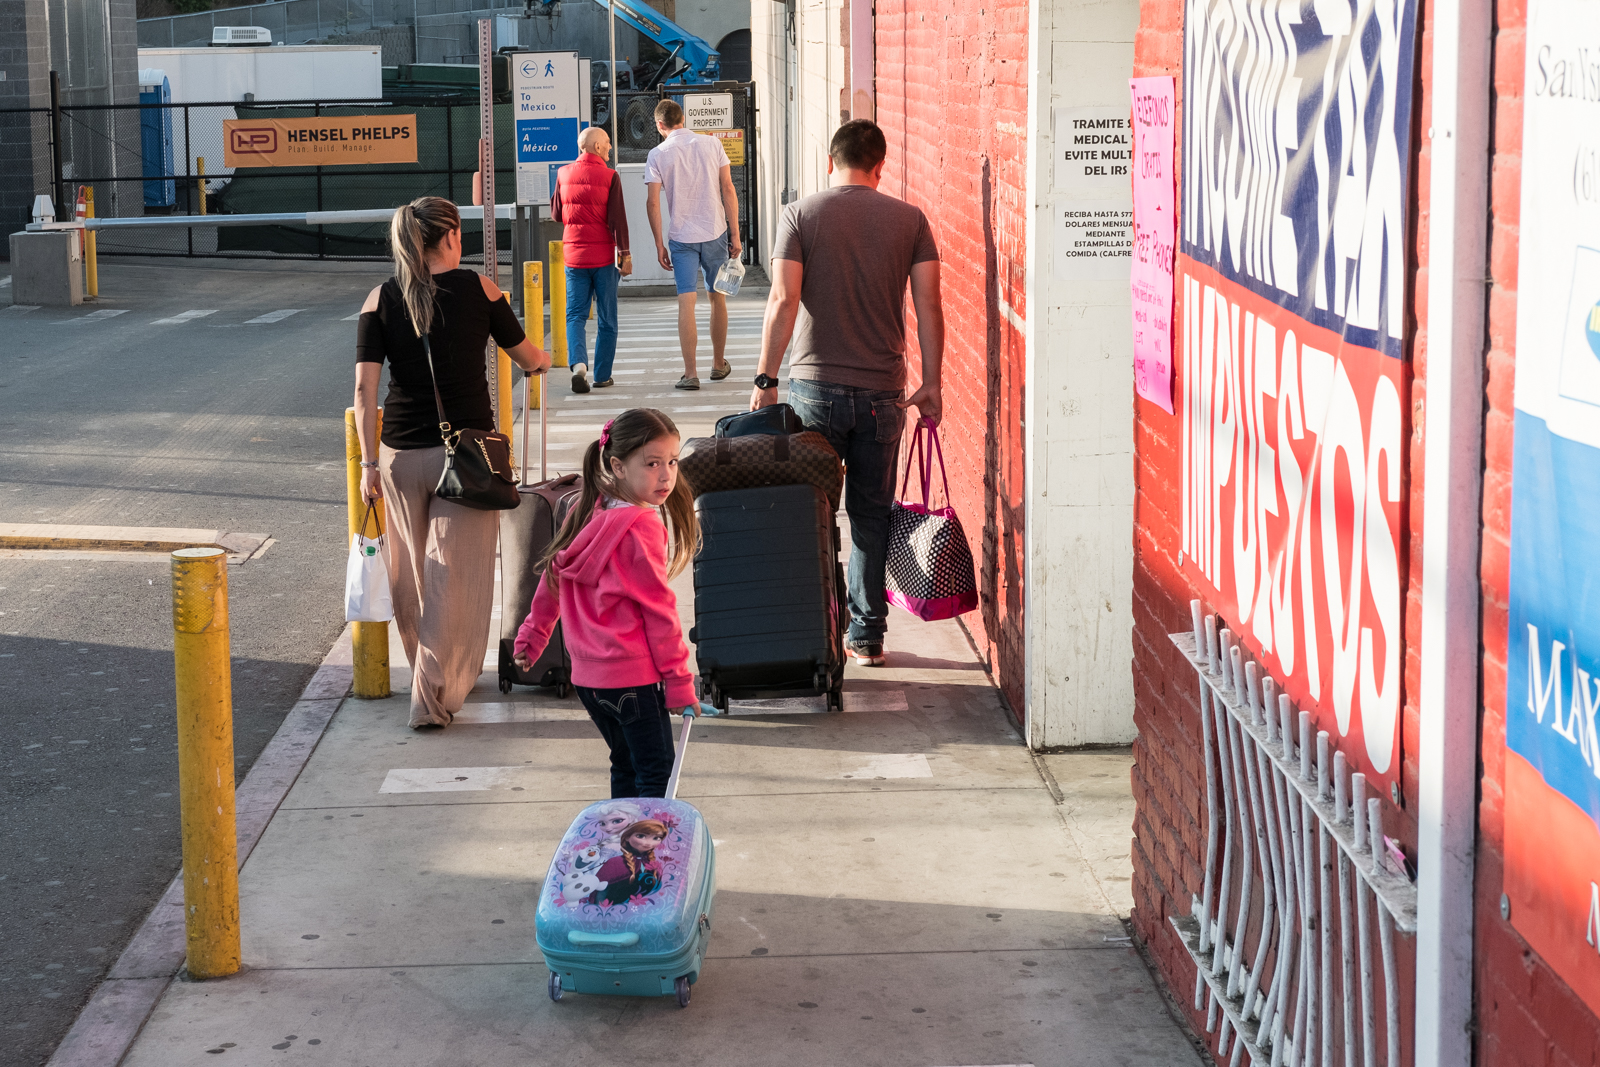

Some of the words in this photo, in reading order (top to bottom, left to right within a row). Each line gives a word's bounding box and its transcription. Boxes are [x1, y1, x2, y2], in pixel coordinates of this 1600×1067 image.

[520, 92, 531, 101] To
[702, 97, 714, 106] U.S.
[521, 102, 556, 112] Mexico
[1131, 84, 1169, 128] TELEFONOS
[688, 107, 729, 117] GOVERNMENT
[693, 118, 724, 127] PROPERTY
[1072, 118, 1124, 129] TRAMITE
[287, 128, 348, 142] HENSEL
[352, 126, 411, 140] PHELPS
[522, 133, 530, 142] A
[1073, 134, 1128, 145] MEDICAL
[288, 146, 309, 154] Plan.
[342, 144, 376, 153] Manage.
[522, 143, 558, 152] México
[1064, 150, 1098, 160] EVITE
[1141, 133, 1162, 179] GRATIS
[1084, 166, 1108, 176] DEL
[1110, 165, 1128, 175] IRS
[1183, 0, 1299, 298] INCOME
[1313, 0, 1404, 341] TAX
[1573, 143, 1600, 206] (61
[1085, 230, 1126, 238] MEDIANTE
[1134, 223, 1150, 263] FREE
[1152, 229, 1173, 276] PHONES
[1182, 272, 1401, 775] IMPUESTOS
